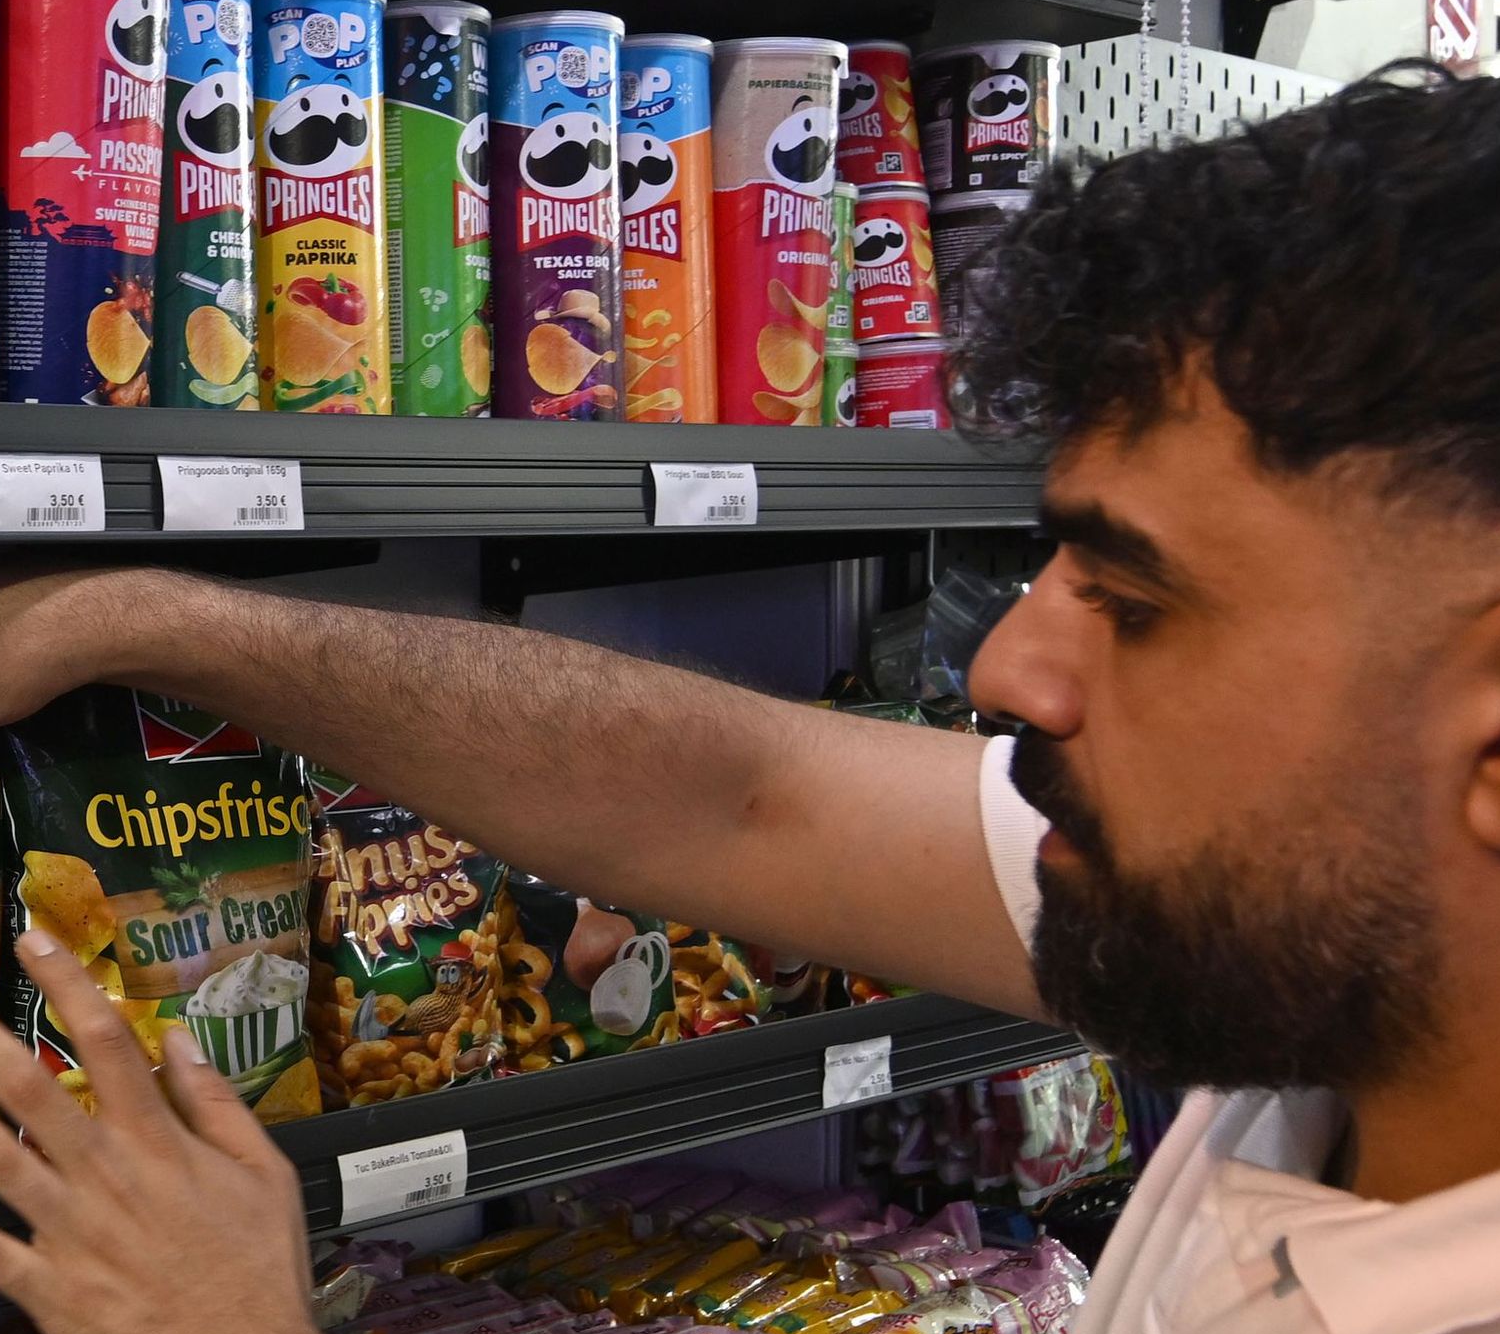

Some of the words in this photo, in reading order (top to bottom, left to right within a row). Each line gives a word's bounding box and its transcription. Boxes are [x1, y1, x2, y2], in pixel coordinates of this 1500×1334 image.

[271, 9, 303, 22] SCAN
[527, 42, 558, 55] SCAN
[336, 55, 361, 69] PLAY
[967, 121, 1030, 147] PRINGLES
[971, 154, 991, 163] HOT
[999, 153, 1027, 162] SPICY
[266, 175, 372, 233] PRINGLES
[95, 208, 137, 224] SWEET
[521, 196, 619, 245] PRINGLES
[126, 225, 155, 241] WINGS
[297, 239, 347, 251] CLASSIC
[285, 252, 357, 267] PAPRIKA
[534, 256, 583, 269] TEXAS
[585, 256, 610, 270] BBQ
[777, 251, 829, 266] ORIGINAL
[558, 269, 595, 280] SAUCE
[853, 263, 911, 292] PRINGLES
[862, 295, 905, 307] ORIGINAL
[1, 463, 32, 473] Sweet
[34, 463, 72, 476] Paprika
[73, 464, 85, 473] 16
[231, 465, 264, 478] Original
[265, 465, 287, 478] 165g
[50, 495, 75, 508] 3,50
[256, 495, 278, 508] 3,50
[722, 495, 739, 506] 3,50
[126, 907, 212, 967] Sour
[354, 1163, 370, 1175] Tuc
[371, 1155, 409, 1171] BakeRolls
